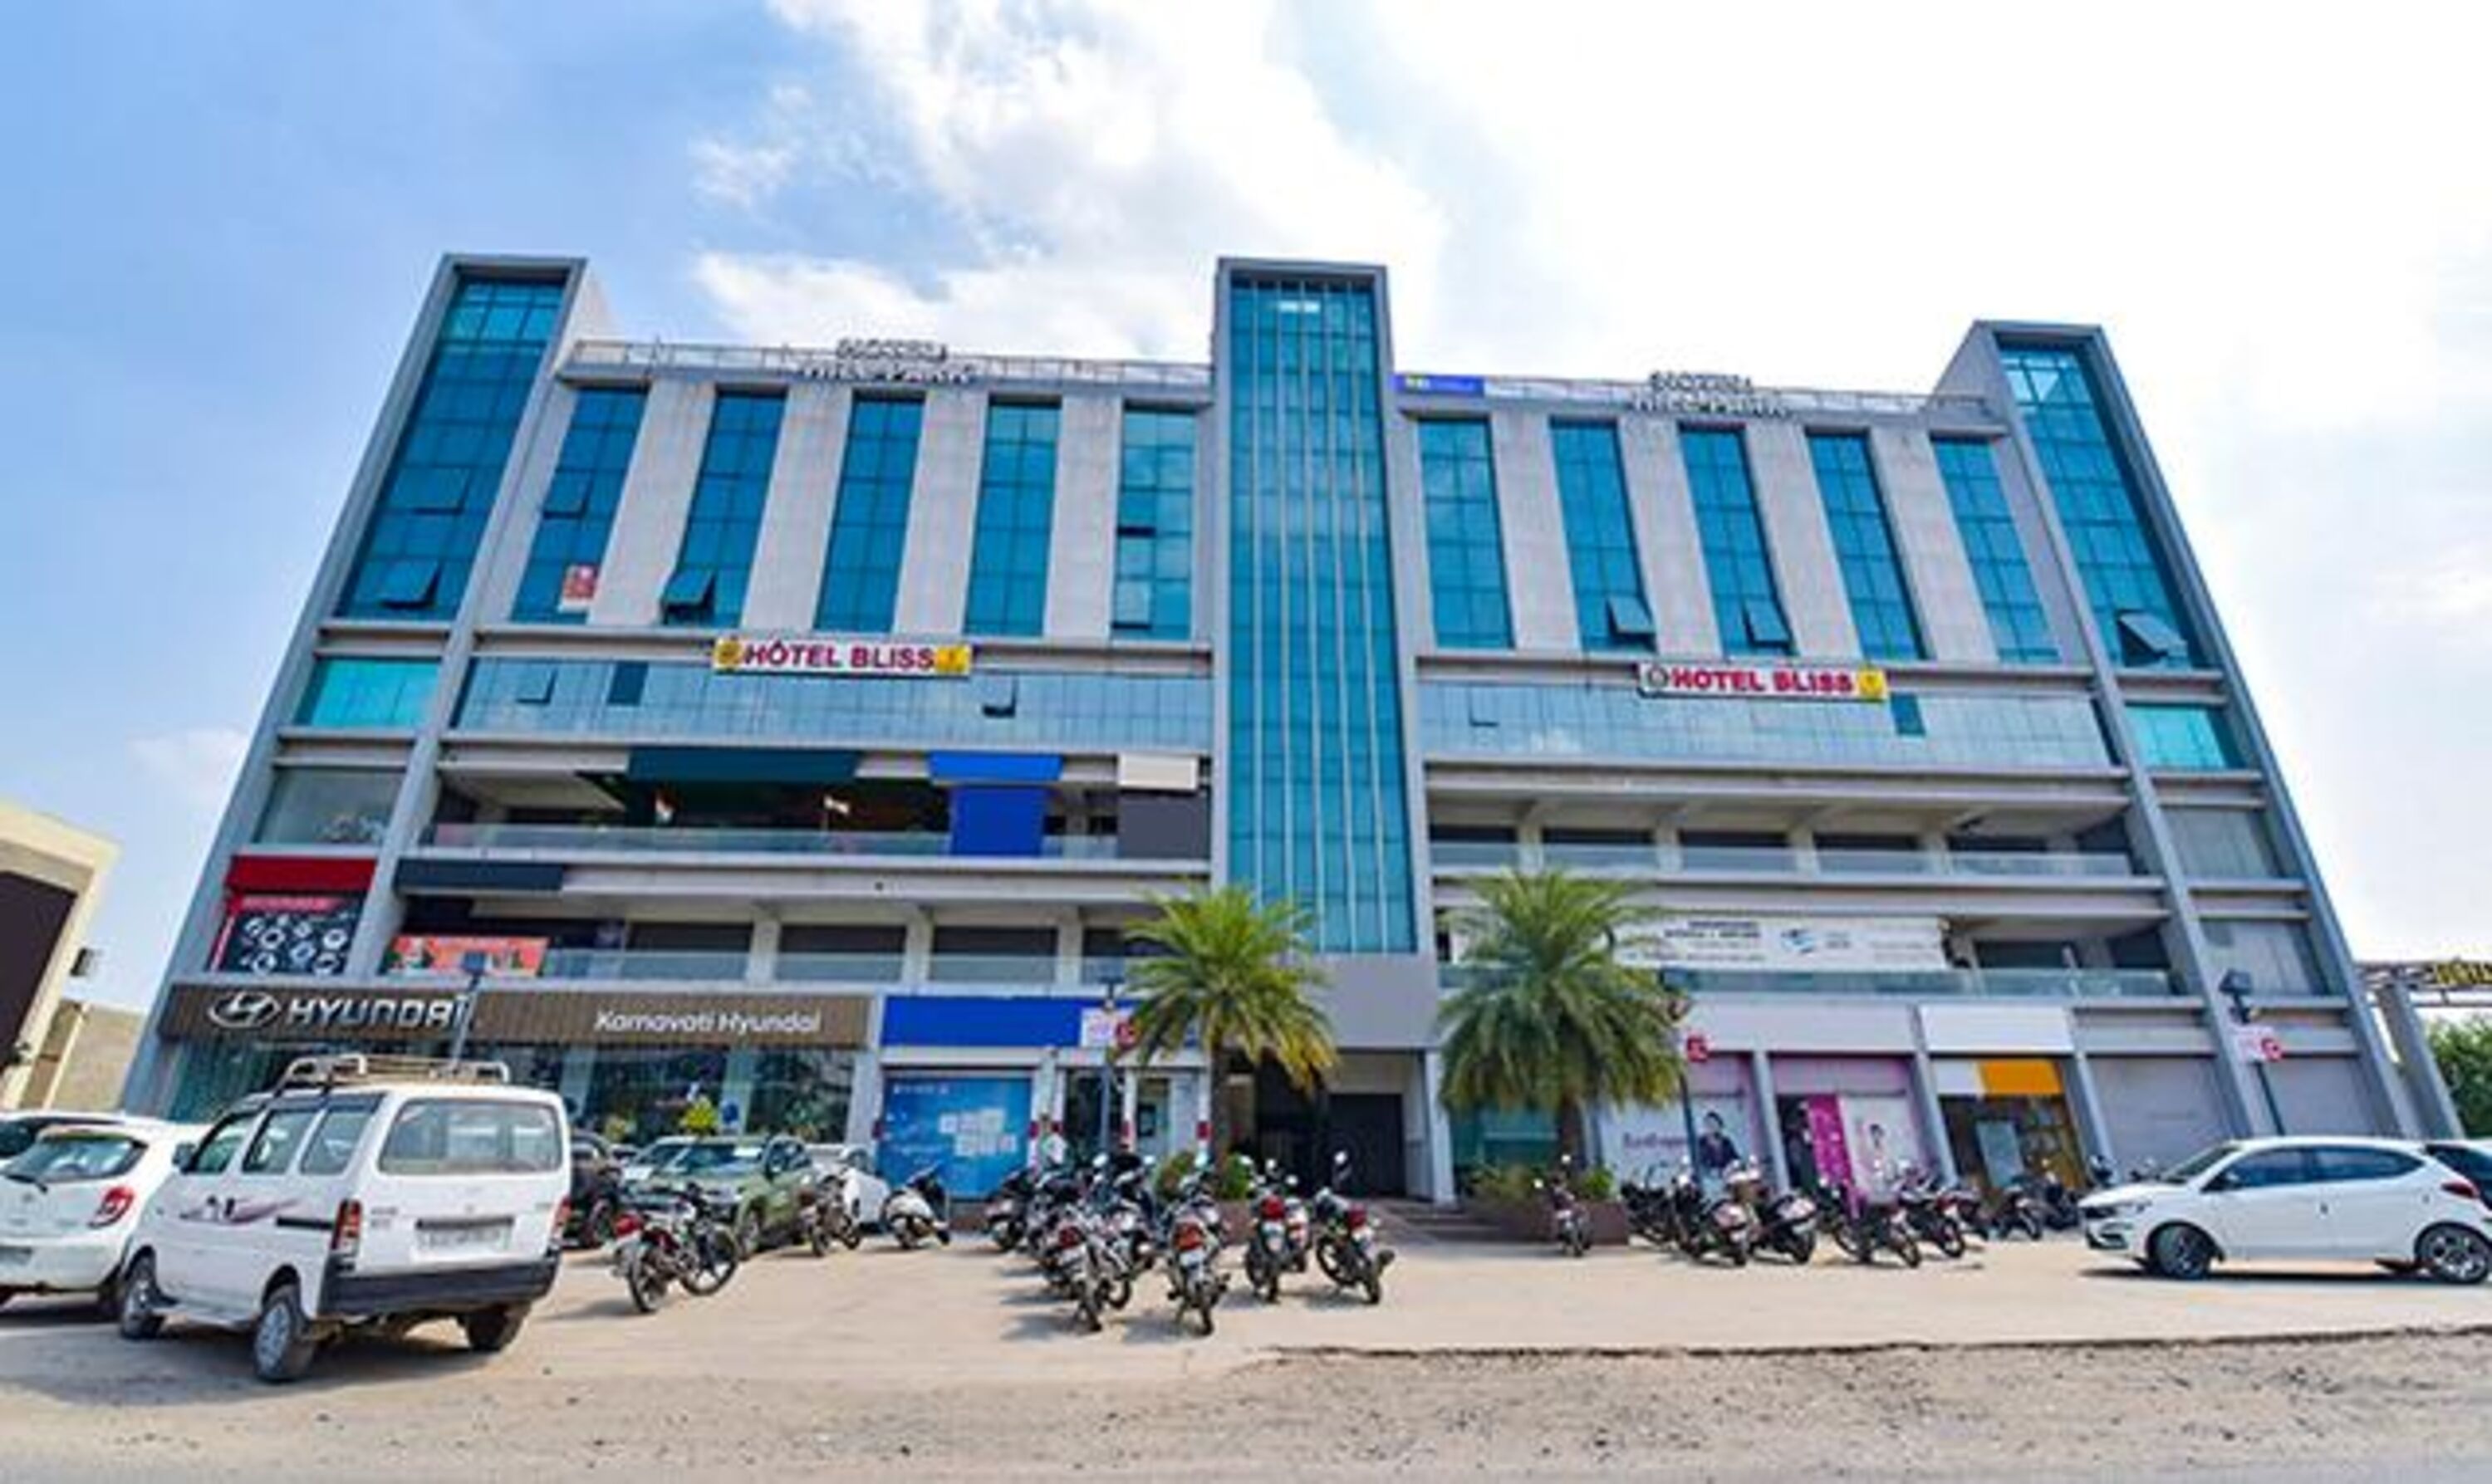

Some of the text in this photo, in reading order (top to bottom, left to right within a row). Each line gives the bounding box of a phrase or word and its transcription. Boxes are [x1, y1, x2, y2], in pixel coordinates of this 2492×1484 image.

[745, 643, 935, 669] HOTEL BLISS
[1671, 667, 1852, 693] HOTEL BLISS
[286, 994, 468, 1029] HYUNDAI
[719, 1010, 822, 1036] Hyundai
